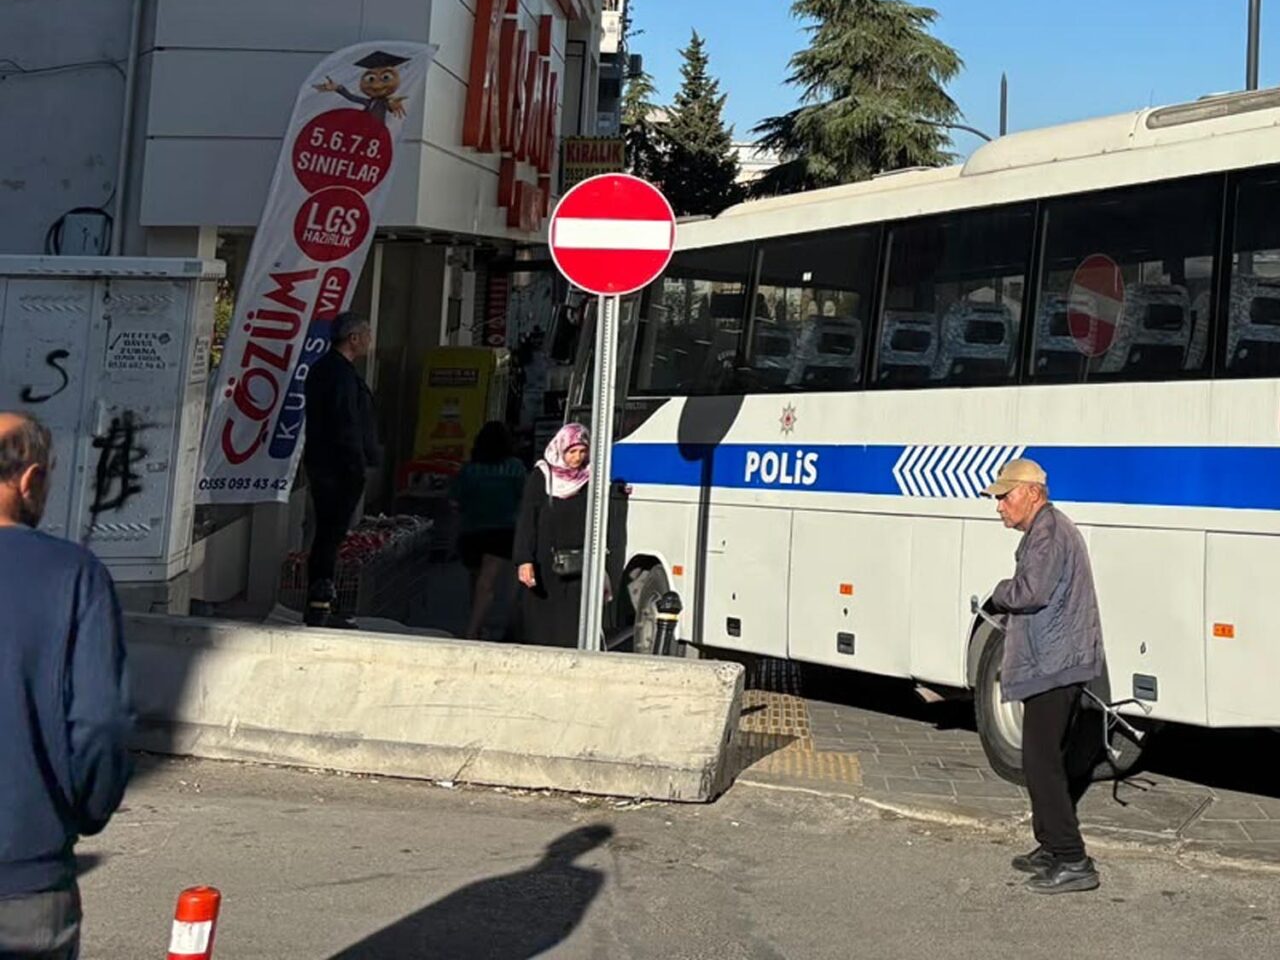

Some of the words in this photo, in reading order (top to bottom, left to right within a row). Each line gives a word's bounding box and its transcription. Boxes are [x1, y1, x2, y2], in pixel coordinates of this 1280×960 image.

[310, 127, 381, 159] 5.6.7.8.
[297, 151, 380, 183] SINIFLAR
[306, 202, 361, 236] LGS
[302, 228, 353, 247] HAZIRLIK
[318, 275, 344, 314] VIP
[221, 268, 320, 464] ÇÖZÜM
[744, 450, 819, 485] POLİS
[271, 478, 288, 491] 42
